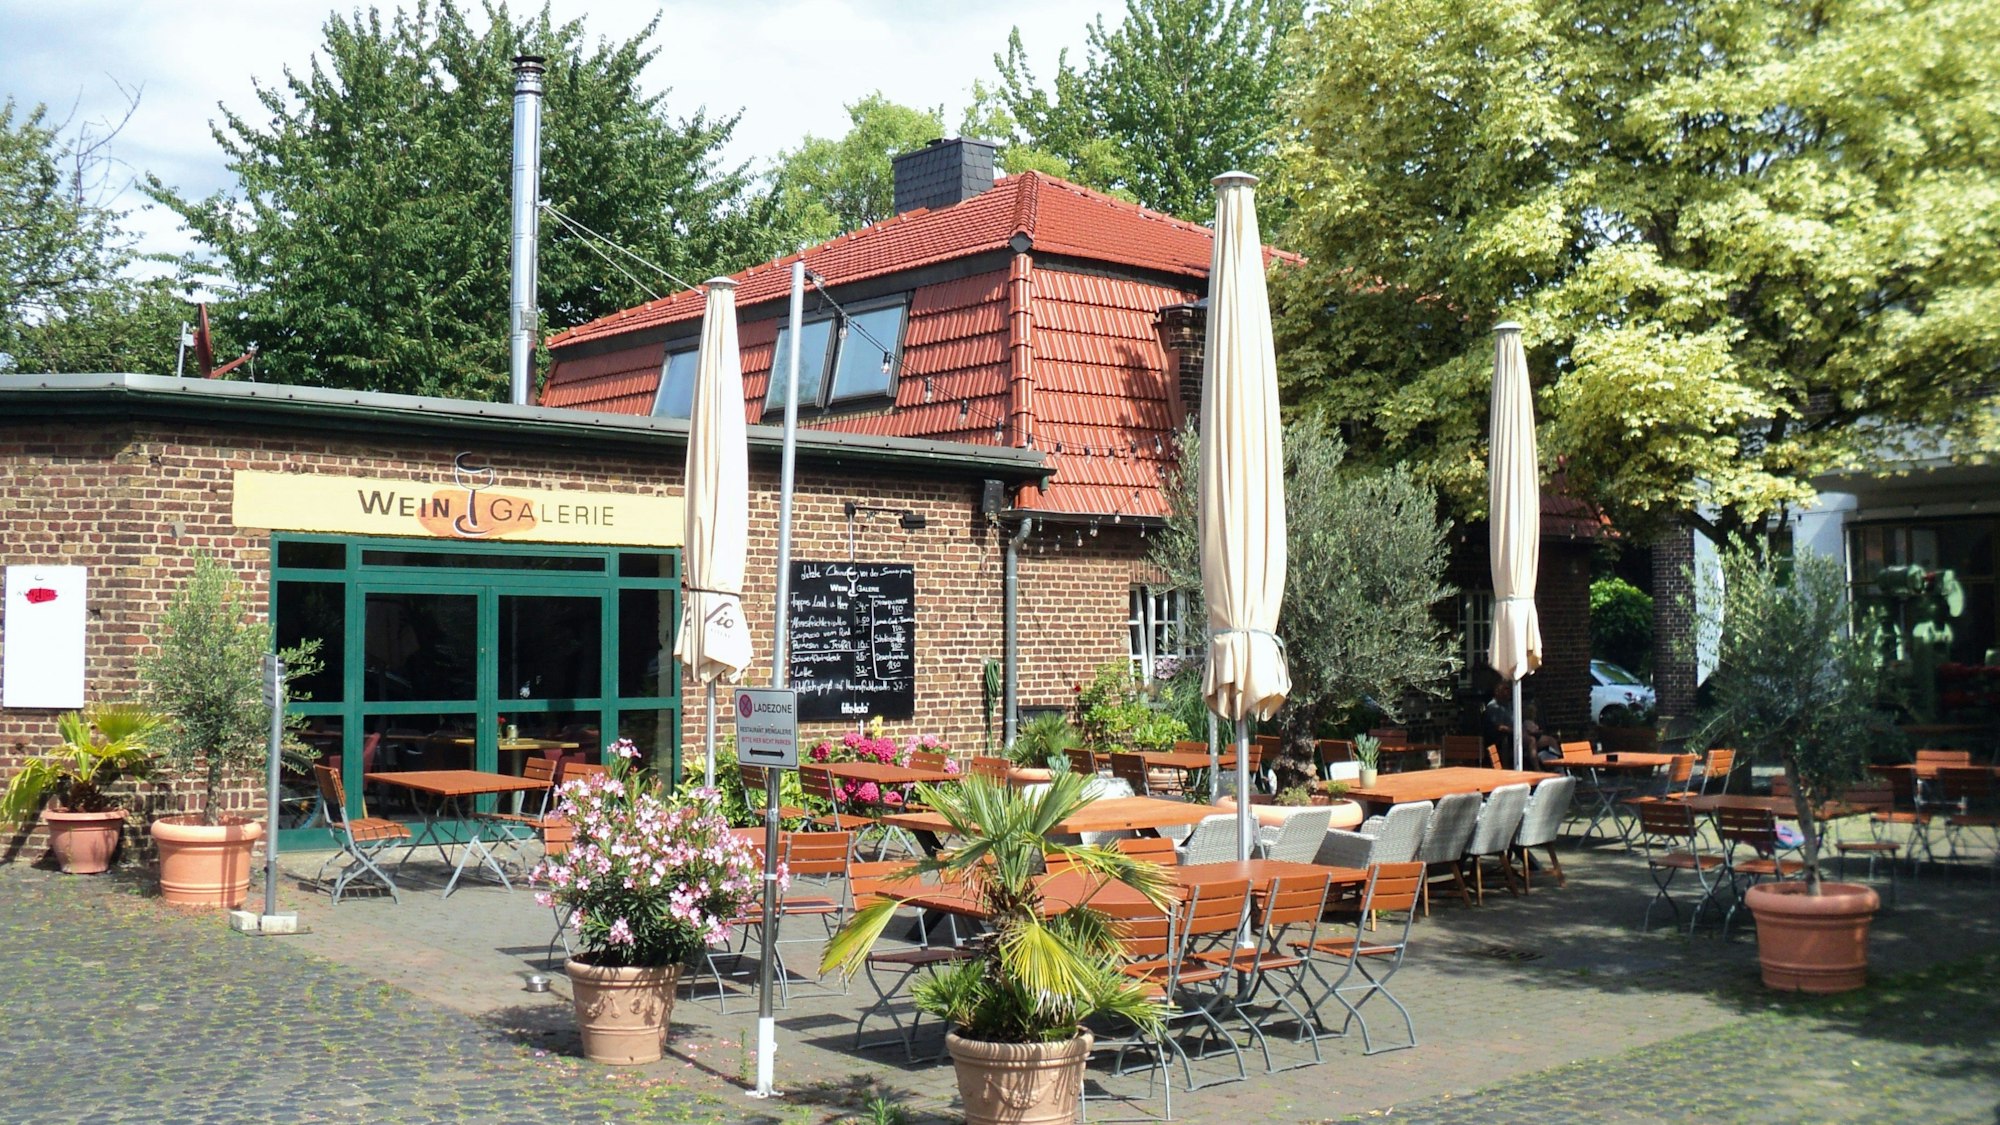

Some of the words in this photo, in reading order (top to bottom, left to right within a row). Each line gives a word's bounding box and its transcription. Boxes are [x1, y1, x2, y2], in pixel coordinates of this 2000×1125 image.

[358, 489, 450, 518] WEIN
[490, 498, 614, 526] GALERIE
[830, 584, 848, 592] WEIN
[856, 584, 880, 593] GALERIE
[753, 703, 792, 714] LADEZONE
[740, 726, 764, 734] RESTAURANT
[775, 738, 792, 746] PARKEN
